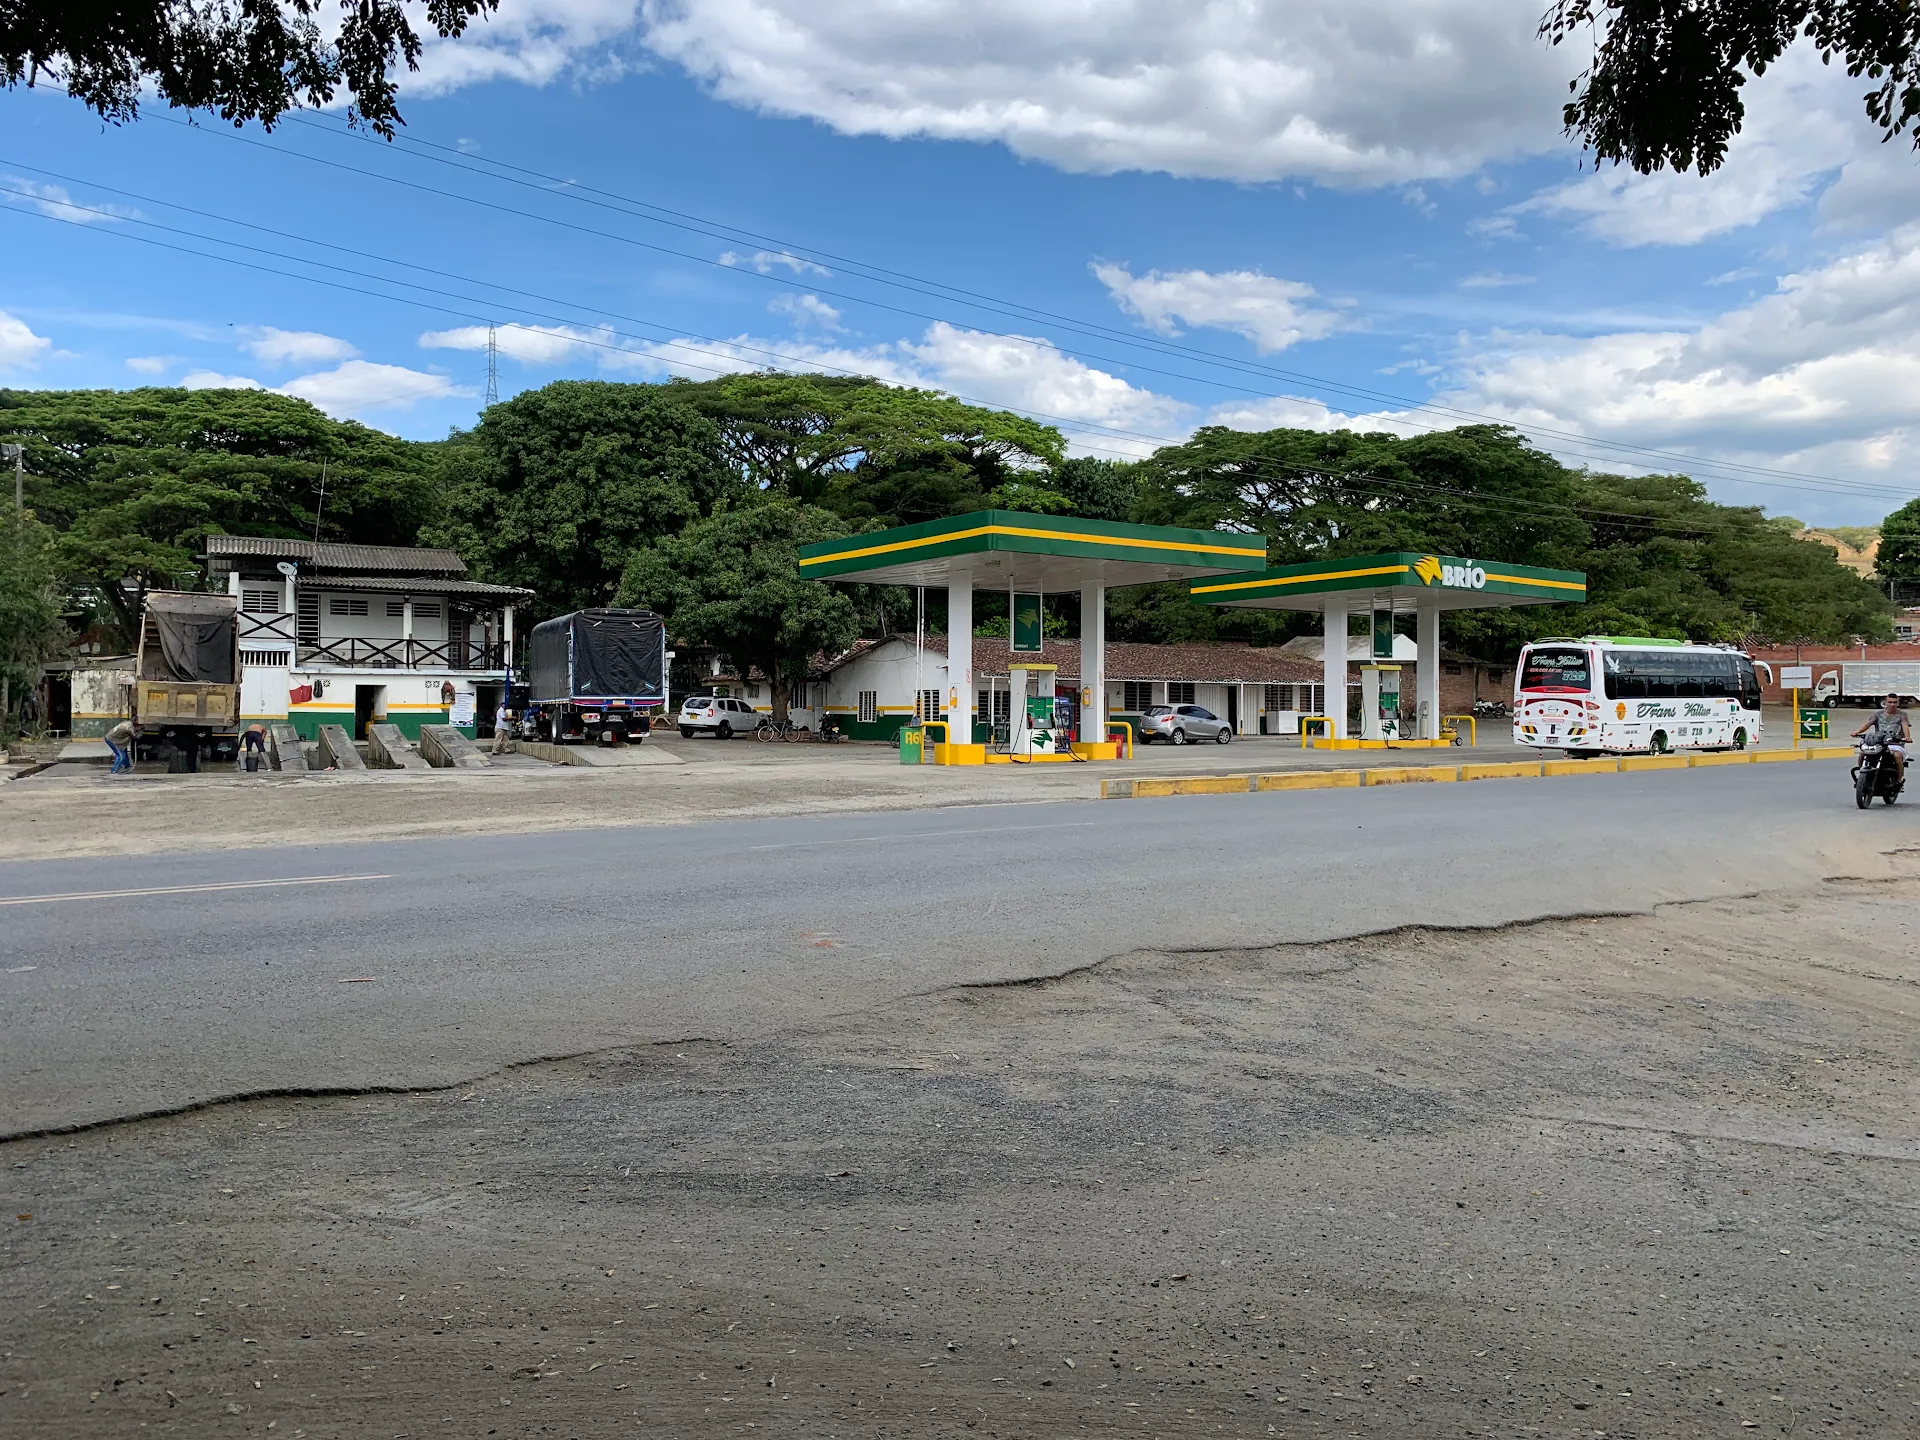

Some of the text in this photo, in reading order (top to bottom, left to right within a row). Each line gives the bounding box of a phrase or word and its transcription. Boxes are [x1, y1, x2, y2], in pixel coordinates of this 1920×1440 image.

[1442, 559, 1486, 588] BRÍO
[1531, 655, 1556, 666] Trans
[1637, 702, 1677, 718] Trans
